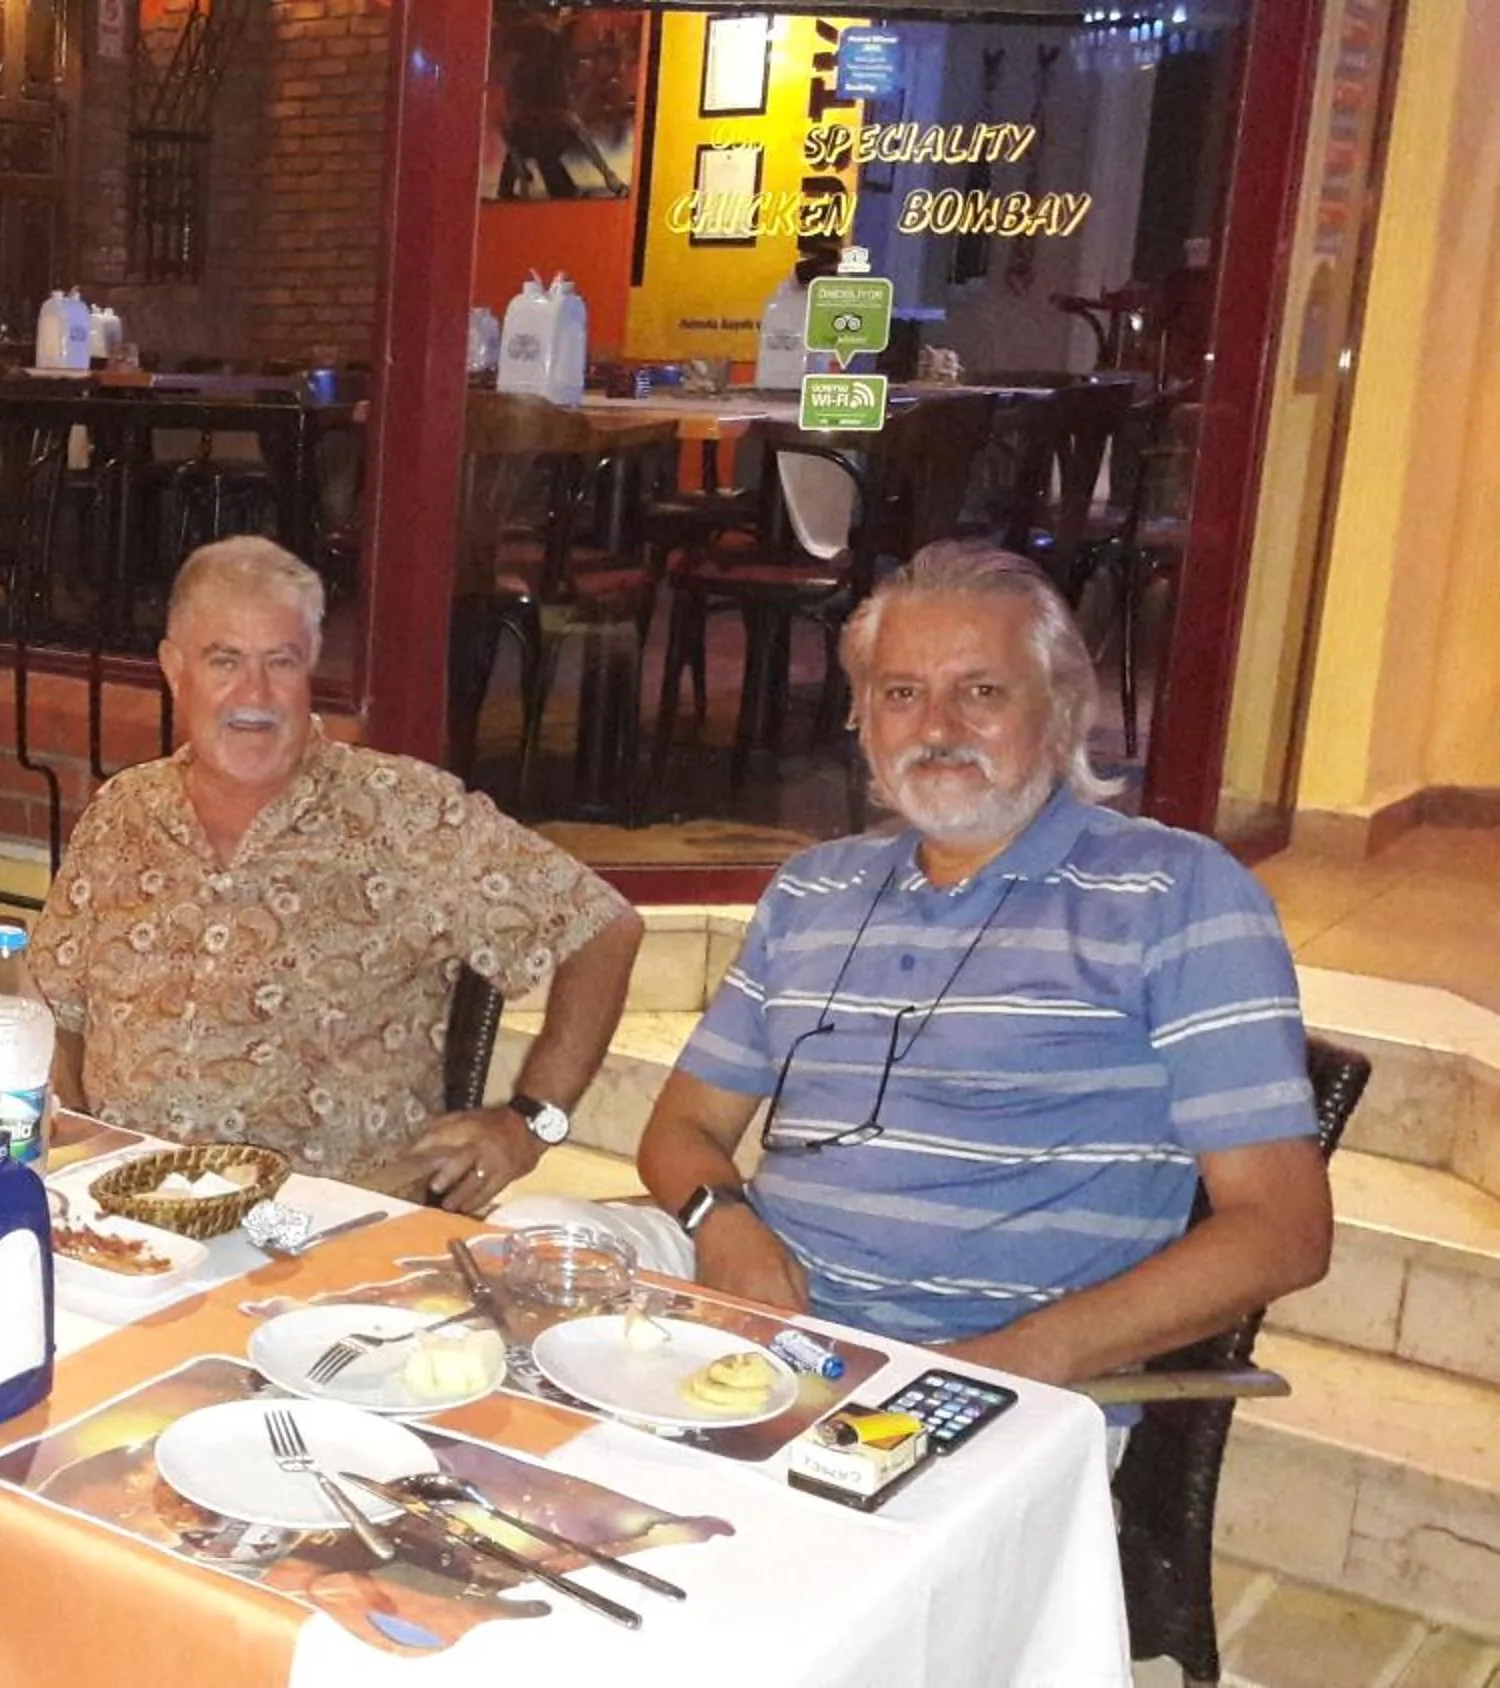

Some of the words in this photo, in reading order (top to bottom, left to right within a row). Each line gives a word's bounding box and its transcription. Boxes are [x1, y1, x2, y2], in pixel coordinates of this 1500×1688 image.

[802, 122, 1036, 164] SPECIALITY
[665, 190, 857, 237] CHICKEN
[897, 188, 1092, 236] BOMBAY
